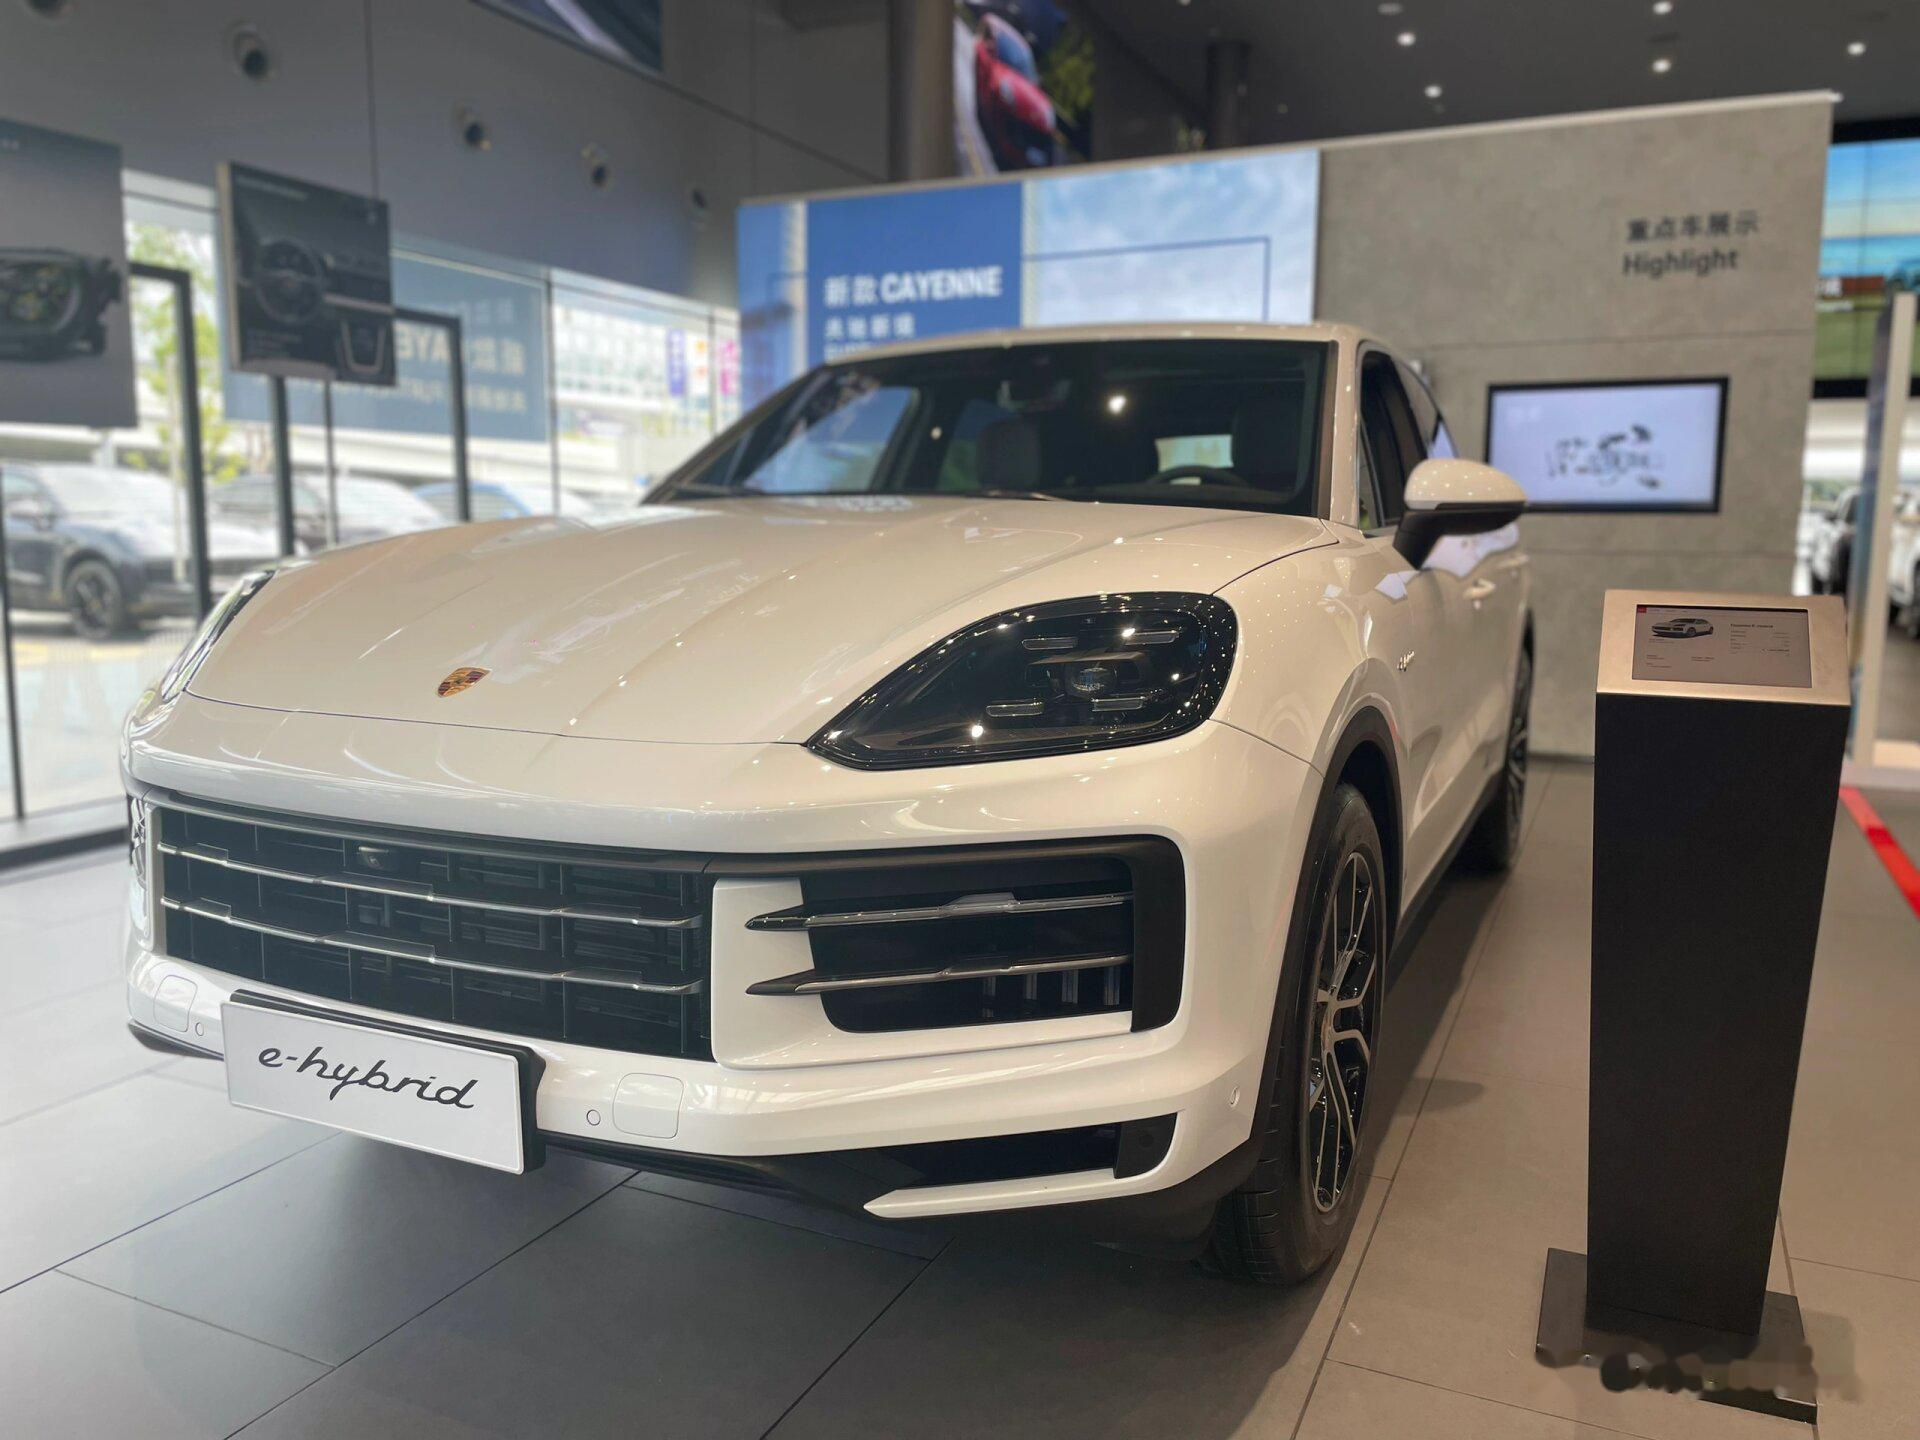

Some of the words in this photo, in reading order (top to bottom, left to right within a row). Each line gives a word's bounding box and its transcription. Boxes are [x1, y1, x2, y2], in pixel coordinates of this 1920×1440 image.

[1623, 248, 1738, 279] Highlight
[881, 266, 1002, 303] CAYENNE
[258, 1046, 479, 1109] e-hybrid
